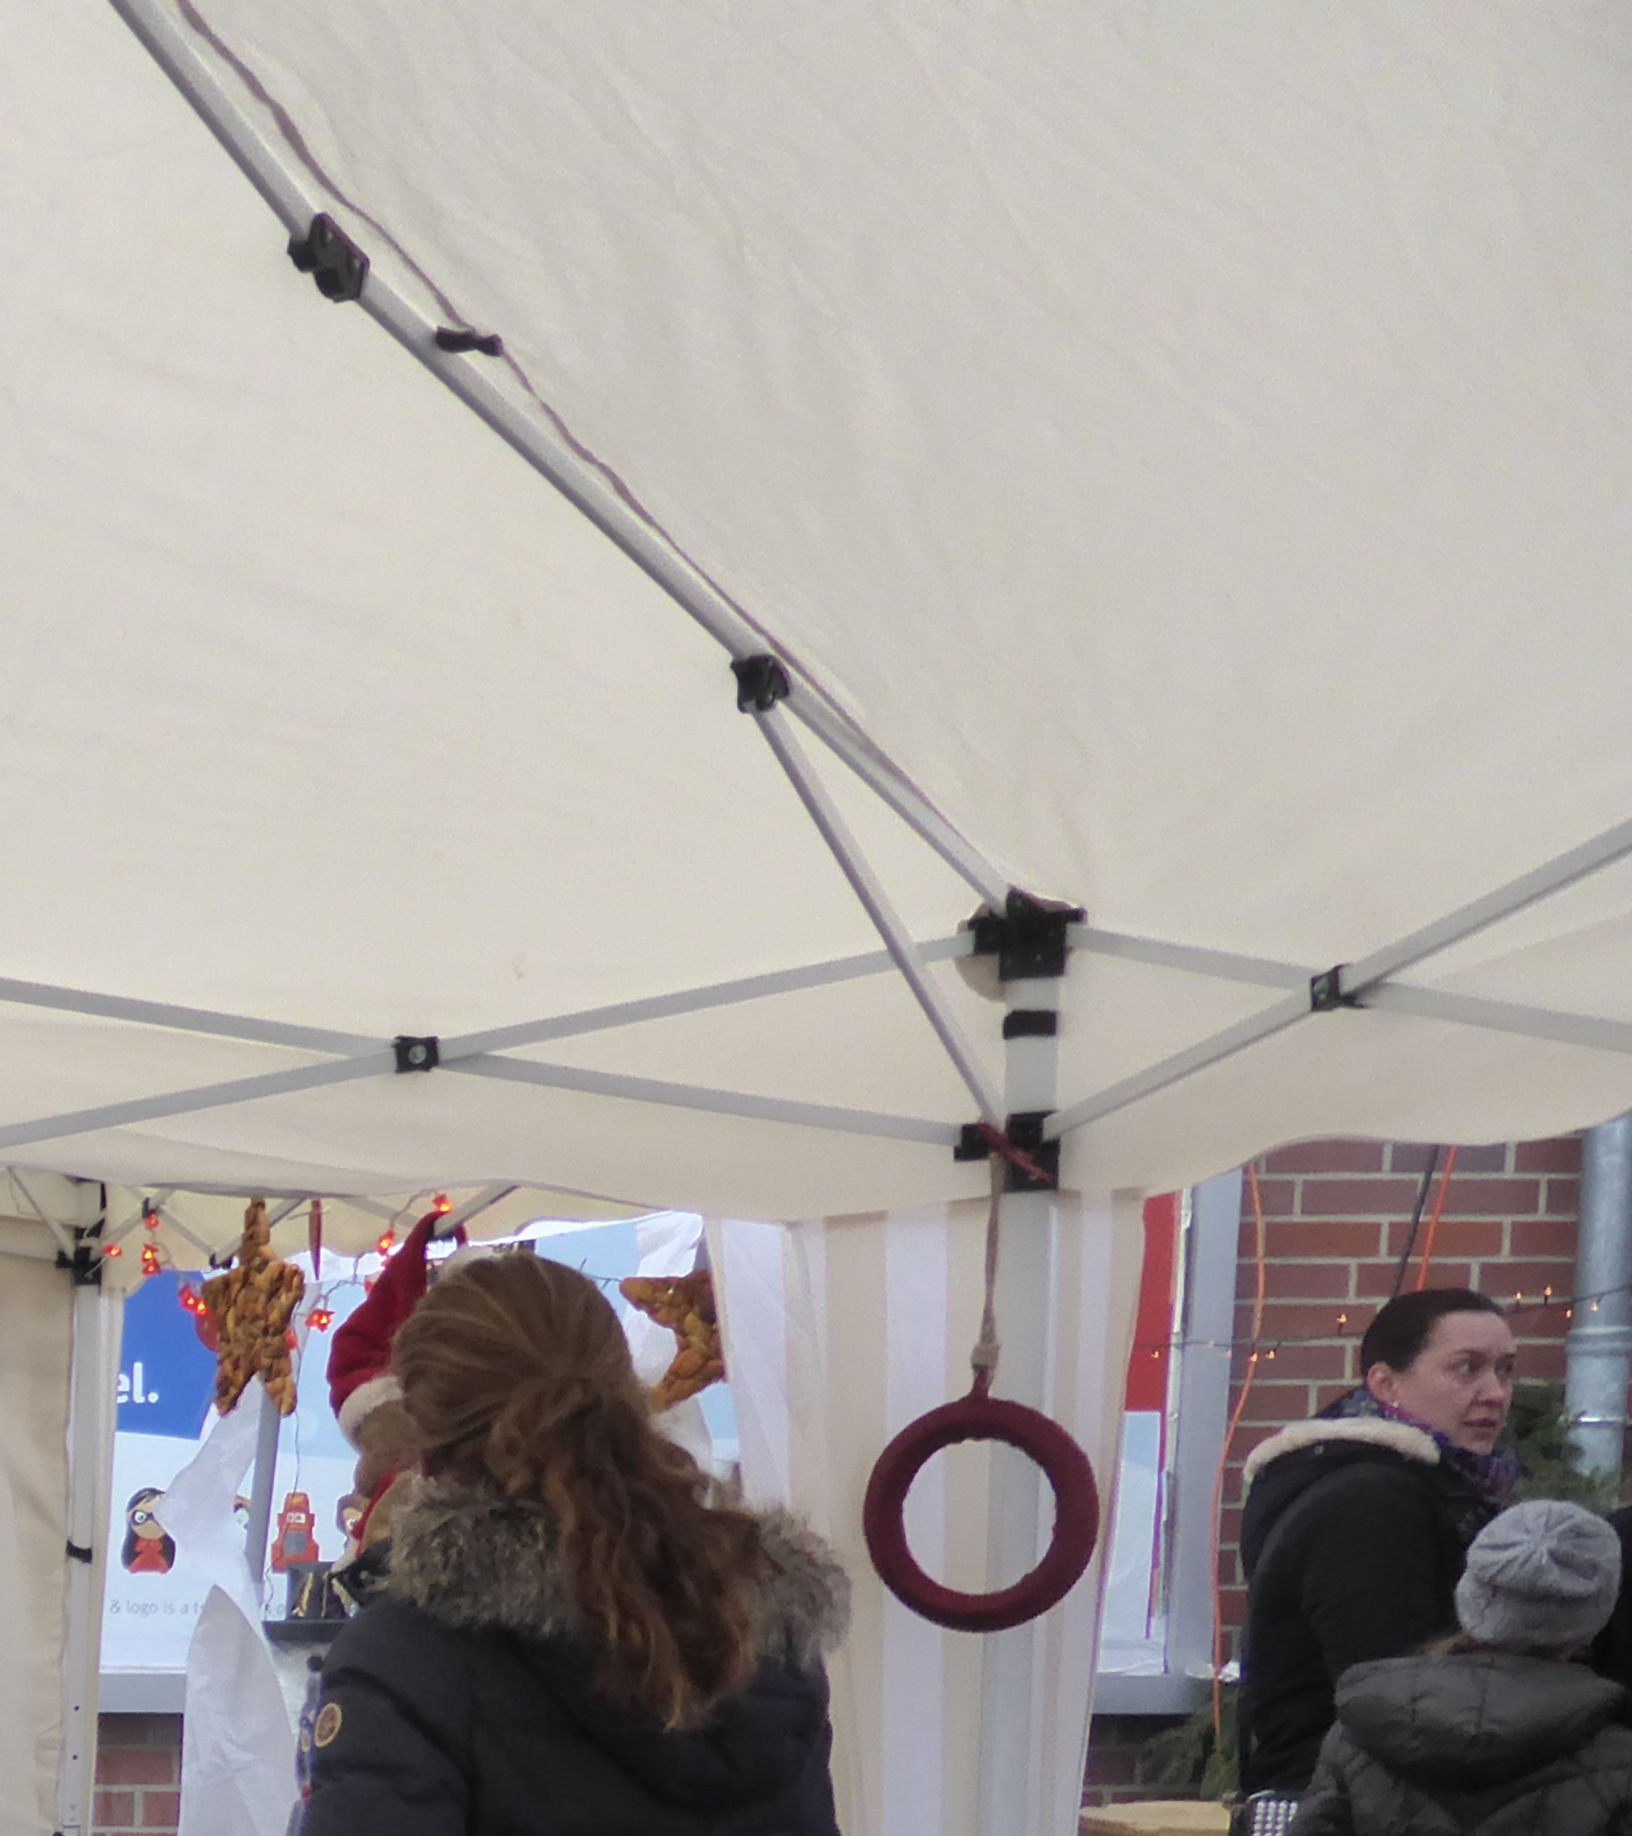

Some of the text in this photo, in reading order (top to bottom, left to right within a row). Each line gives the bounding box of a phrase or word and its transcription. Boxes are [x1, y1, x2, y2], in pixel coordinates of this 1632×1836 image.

[126, 1600, 159, 1617] logo
[163, 1600, 175, 1615] is
[179, 1602, 189, 1615] a
